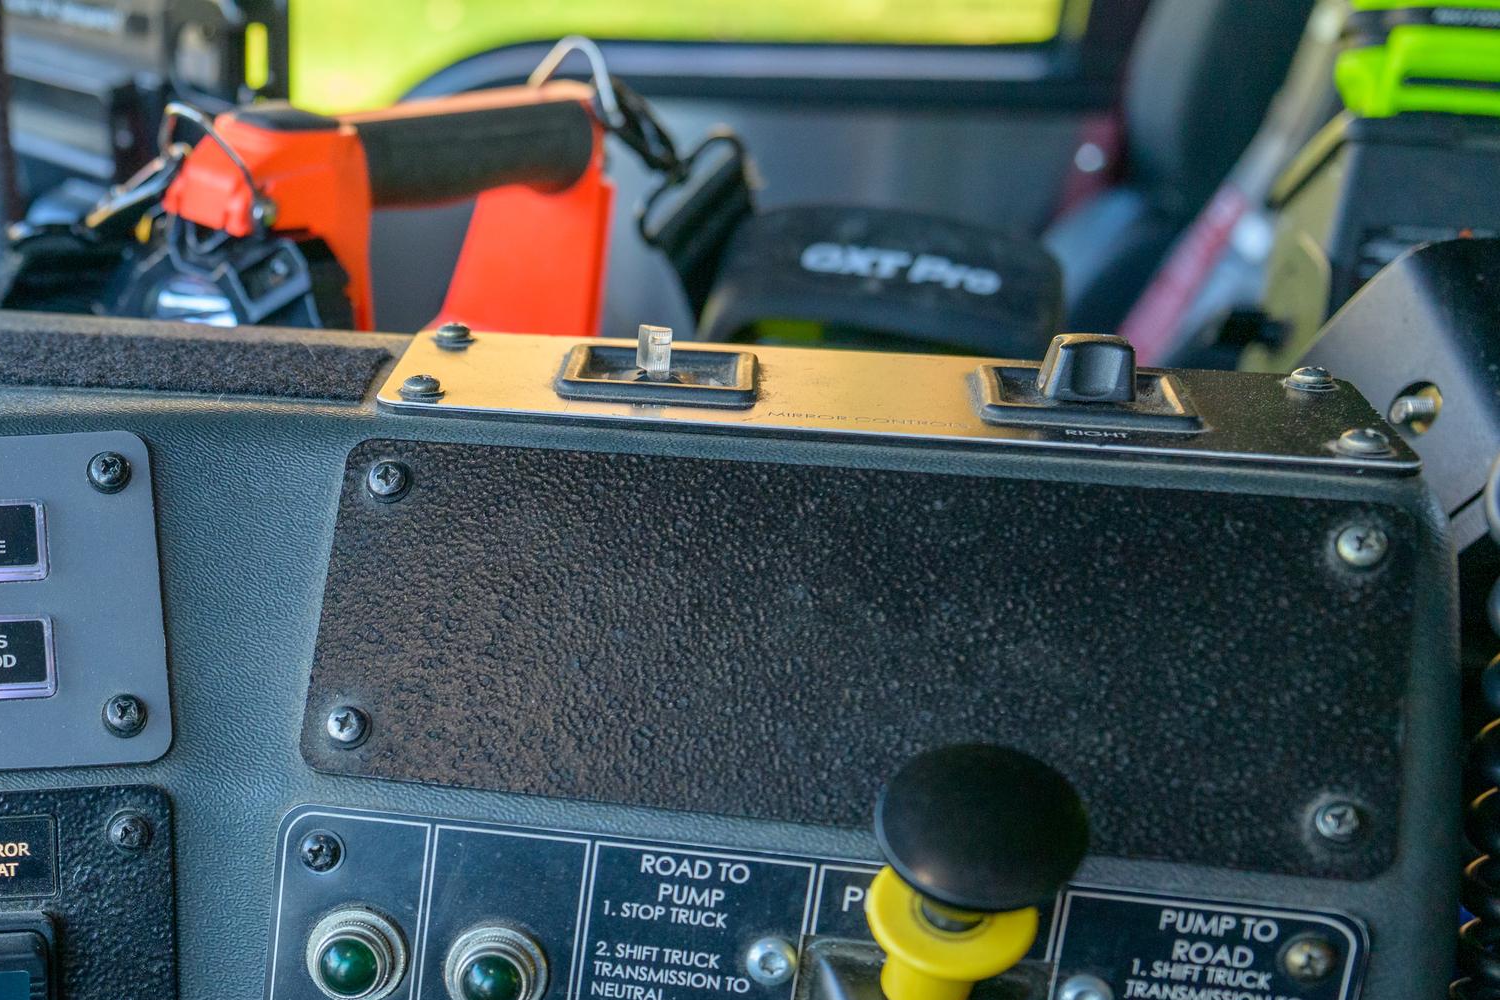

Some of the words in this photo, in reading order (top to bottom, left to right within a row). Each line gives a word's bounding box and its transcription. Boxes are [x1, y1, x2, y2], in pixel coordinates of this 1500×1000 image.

[907, 254, 1002, 295] Pro
[1065, 429, 1128, 438] RIGHT
[640, 854, 712, 880] ROAD
[718, 862, 750, 884] TO
[657, 883, 725, 908] PUMP
[603, 900, 616, 917] 1.
[620, 902, 666, 921] STOP
[670, 907, 728, 929] TRUCK
[1159, 908, 1235, 938] PUMP
[1242, 918, 1279, 943] TO
[595, 941, 611, 957] 2.
[615, 943, 660, 962] SHIFT
[663, 948, 721, 970] TRUCK
[1171, 939, 1254, 969] ROAD
[593, 961, 721, 991] TRANSMISSION
[725, 977, 750, 994] TO
[1131, 958, 1147, 977] 1.
[1150, 960, 1204, 983] SHIFT
[1206, 967, 1273, 991] TRUCK
